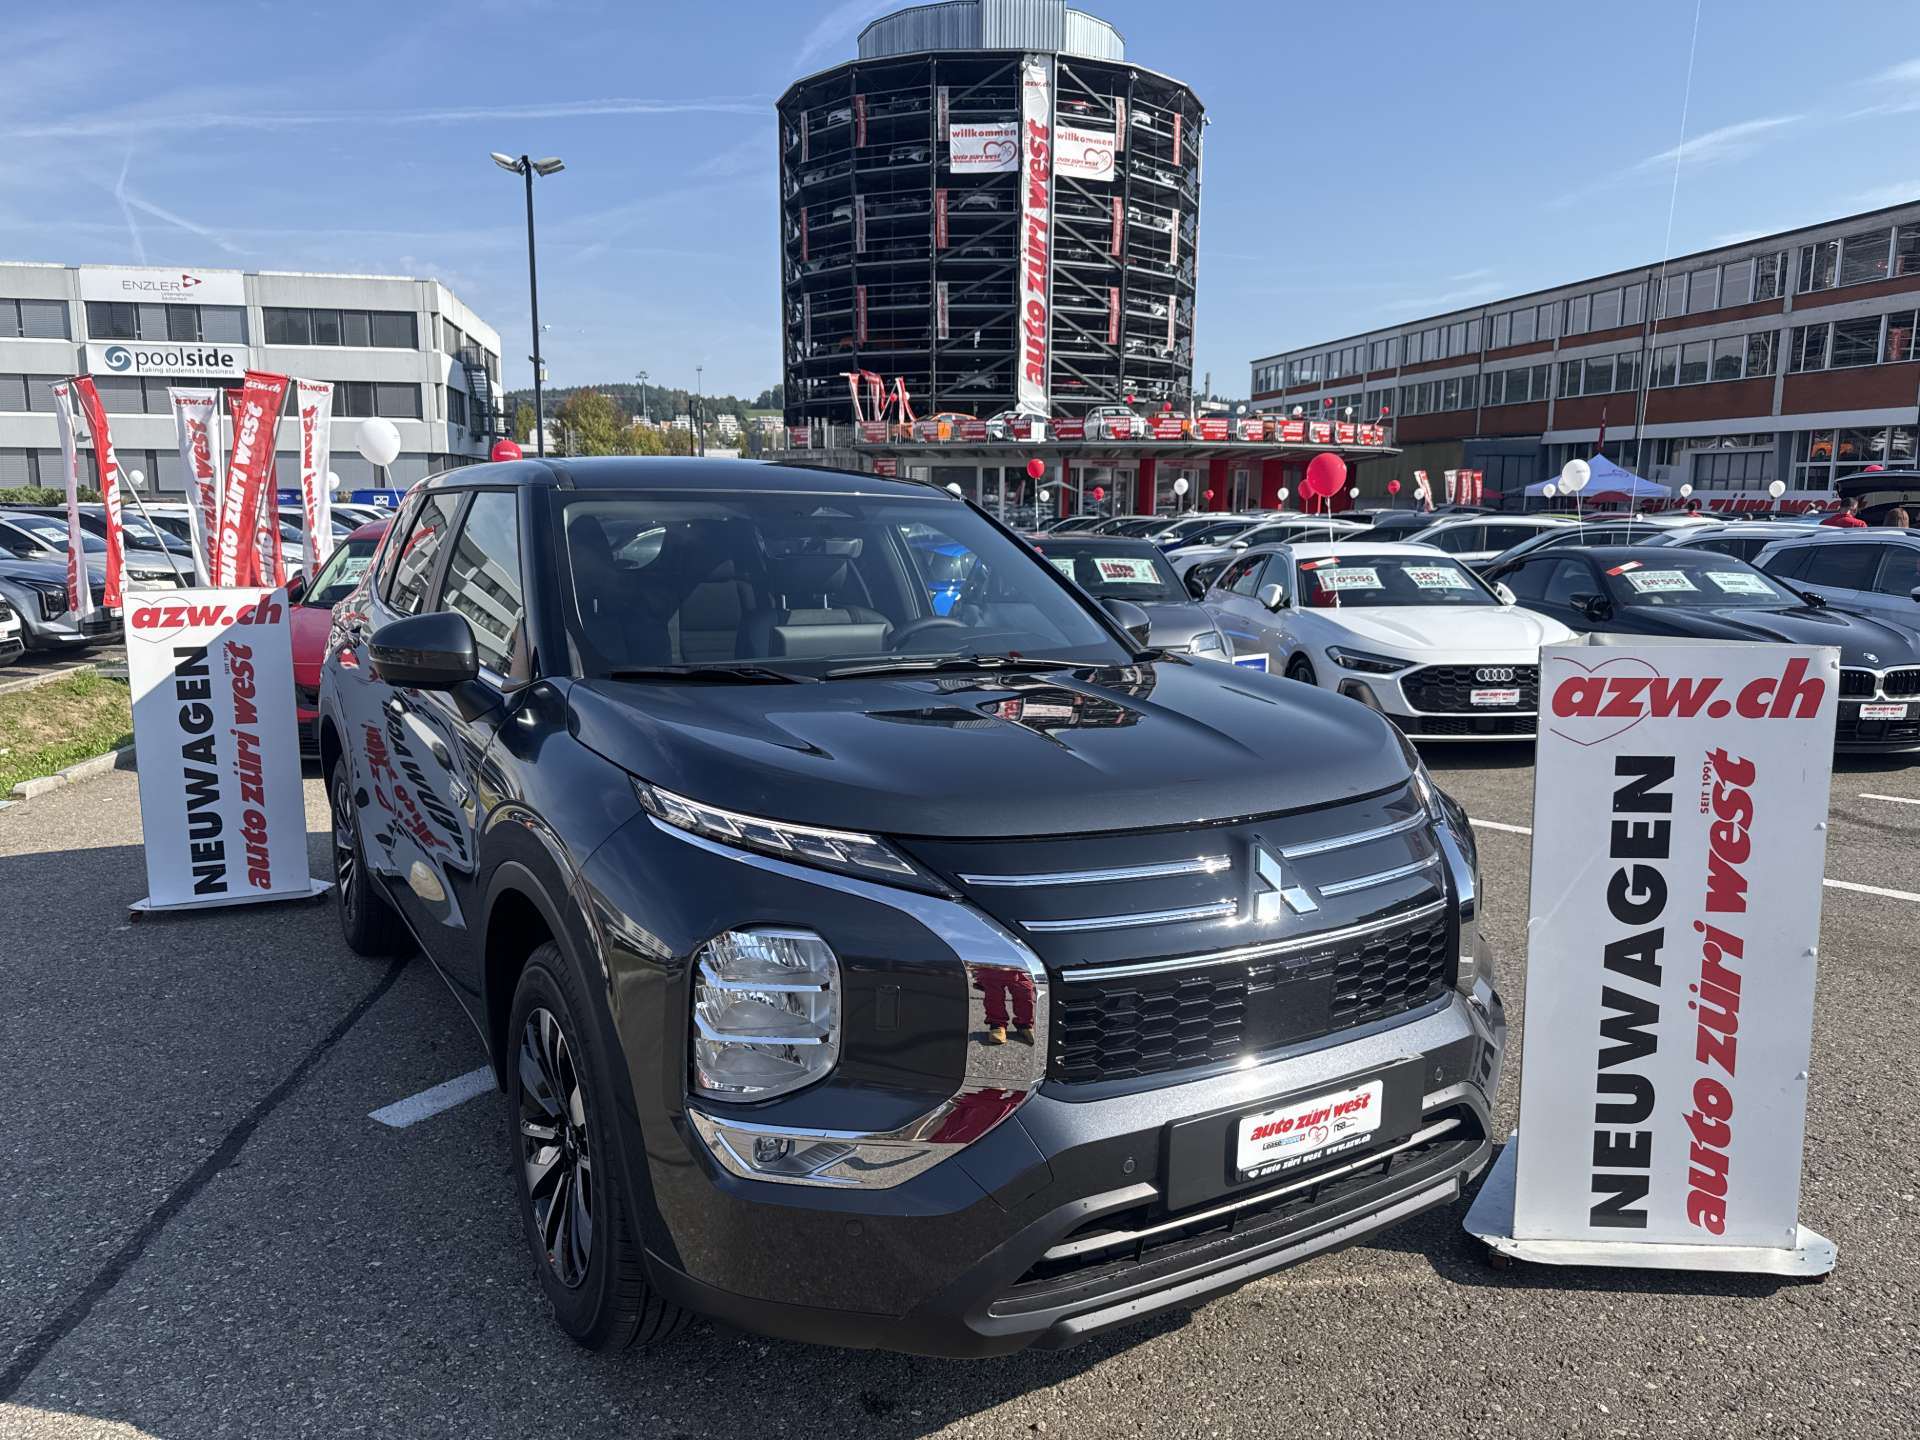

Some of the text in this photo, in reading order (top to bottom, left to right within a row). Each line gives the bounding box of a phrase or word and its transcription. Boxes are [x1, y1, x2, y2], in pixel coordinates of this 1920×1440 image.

[952, 128, 1017, 138] willkommen
[1056, 131, 1113, 146] willkommen
[1022, 118, 1051, 387] auto züri west
[122, 280, 181, 292] ENZLER
[135, 348, 234, 373] poolside
[175, 397, 213, 406] azw.ch
[245, 380, 281, 393] azw.ch
[236, 401, 264, 465] west
[131, 594, 282, 629] azw.ch
[1551, 658, 1825, 719] azw.ch
[173, 646, 228, 895] NEUWAGEN
[225, 640, 272, 890] auto züri west
[1700, 759, 1713, 815] SEIT 1991
[1589, 755, 1676, 1229] NEUWAGEN
[1681, 747, 1757, 1236] auto züri west
[1250, 1117, 1294, 1141] auto
[1294, 1104, 1332, 1130] züri
[1333, 1092, 1371, 1118] west
[1260, 1163, 1281, 1176] auto
[1303, 1150, 1322, 1164] west
[1326, 1133, 1372, 1156] www.azw.ch
